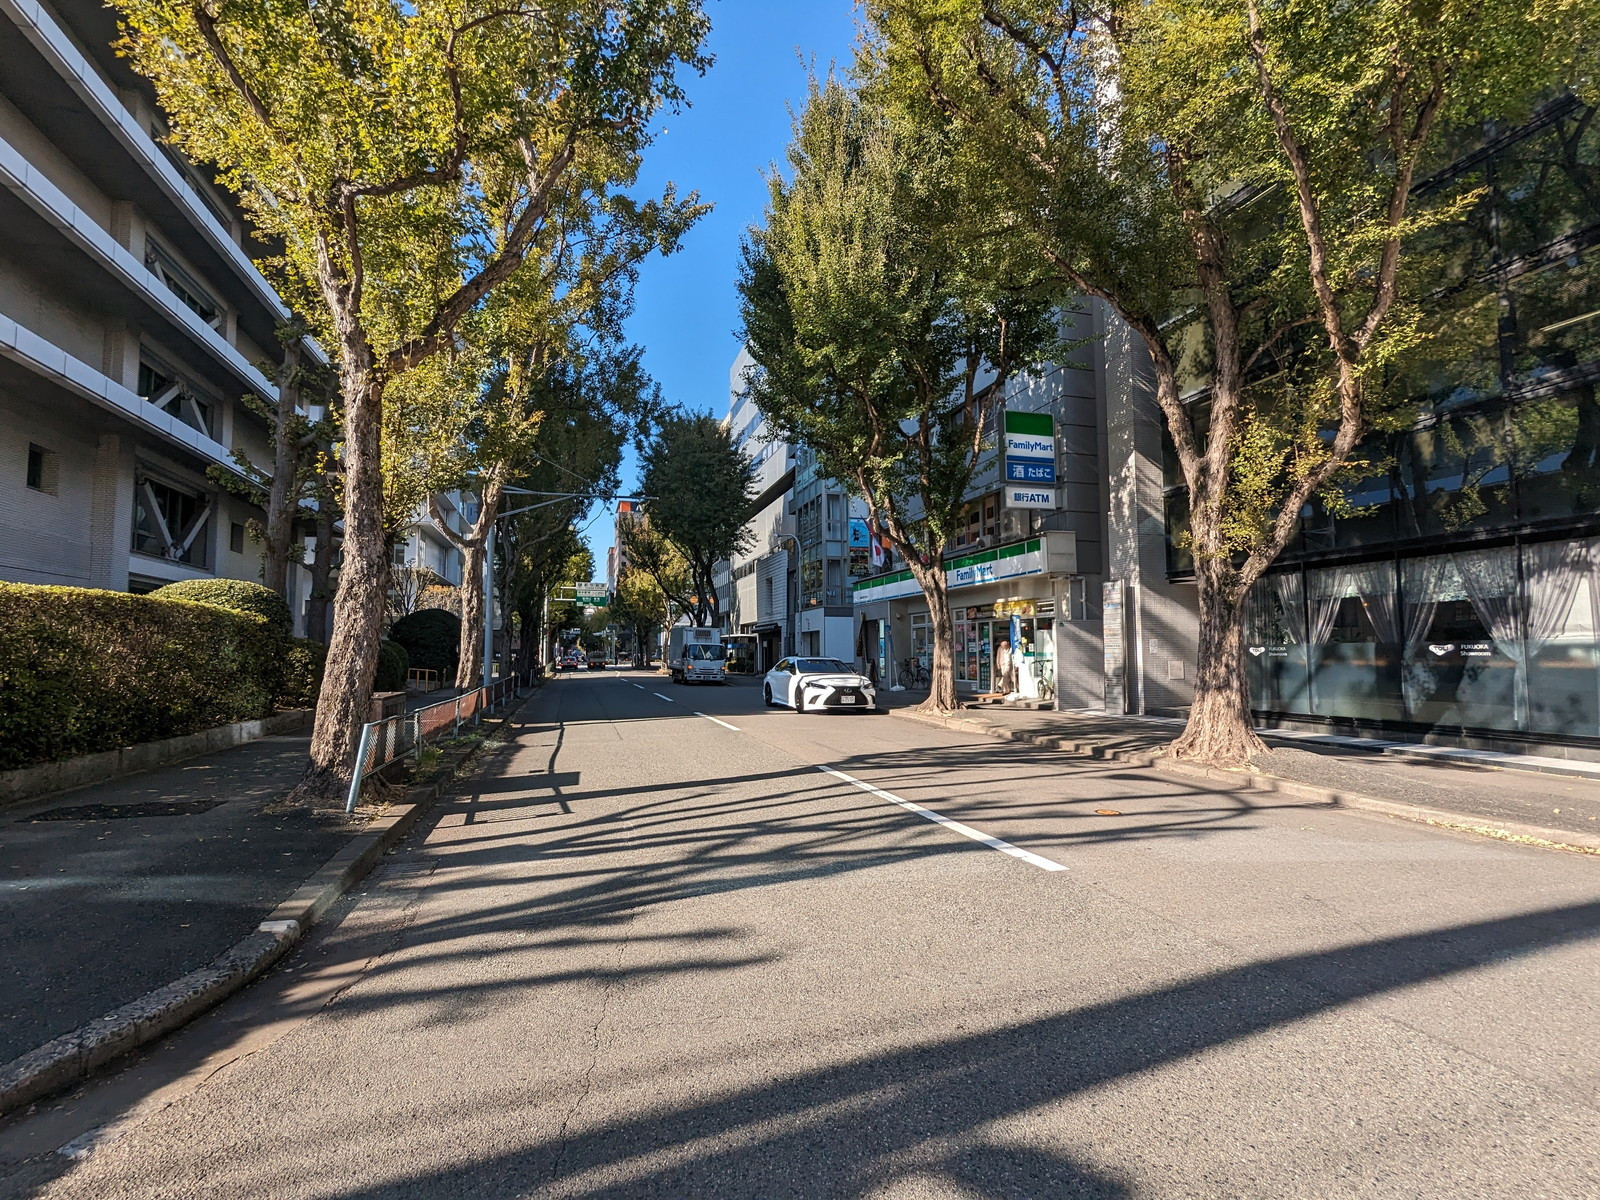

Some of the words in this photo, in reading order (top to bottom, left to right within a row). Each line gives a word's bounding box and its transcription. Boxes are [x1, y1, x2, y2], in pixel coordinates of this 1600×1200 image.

[1008, 439, 1053, 452] FamilyMart
[1012, 465, 1025, 478] 酒
[1028, 467, 1051, 478] たばこ
[1013, 492, 1050, 503] 銀行ATM
[956, 564, 993, 581] FamilyMart
